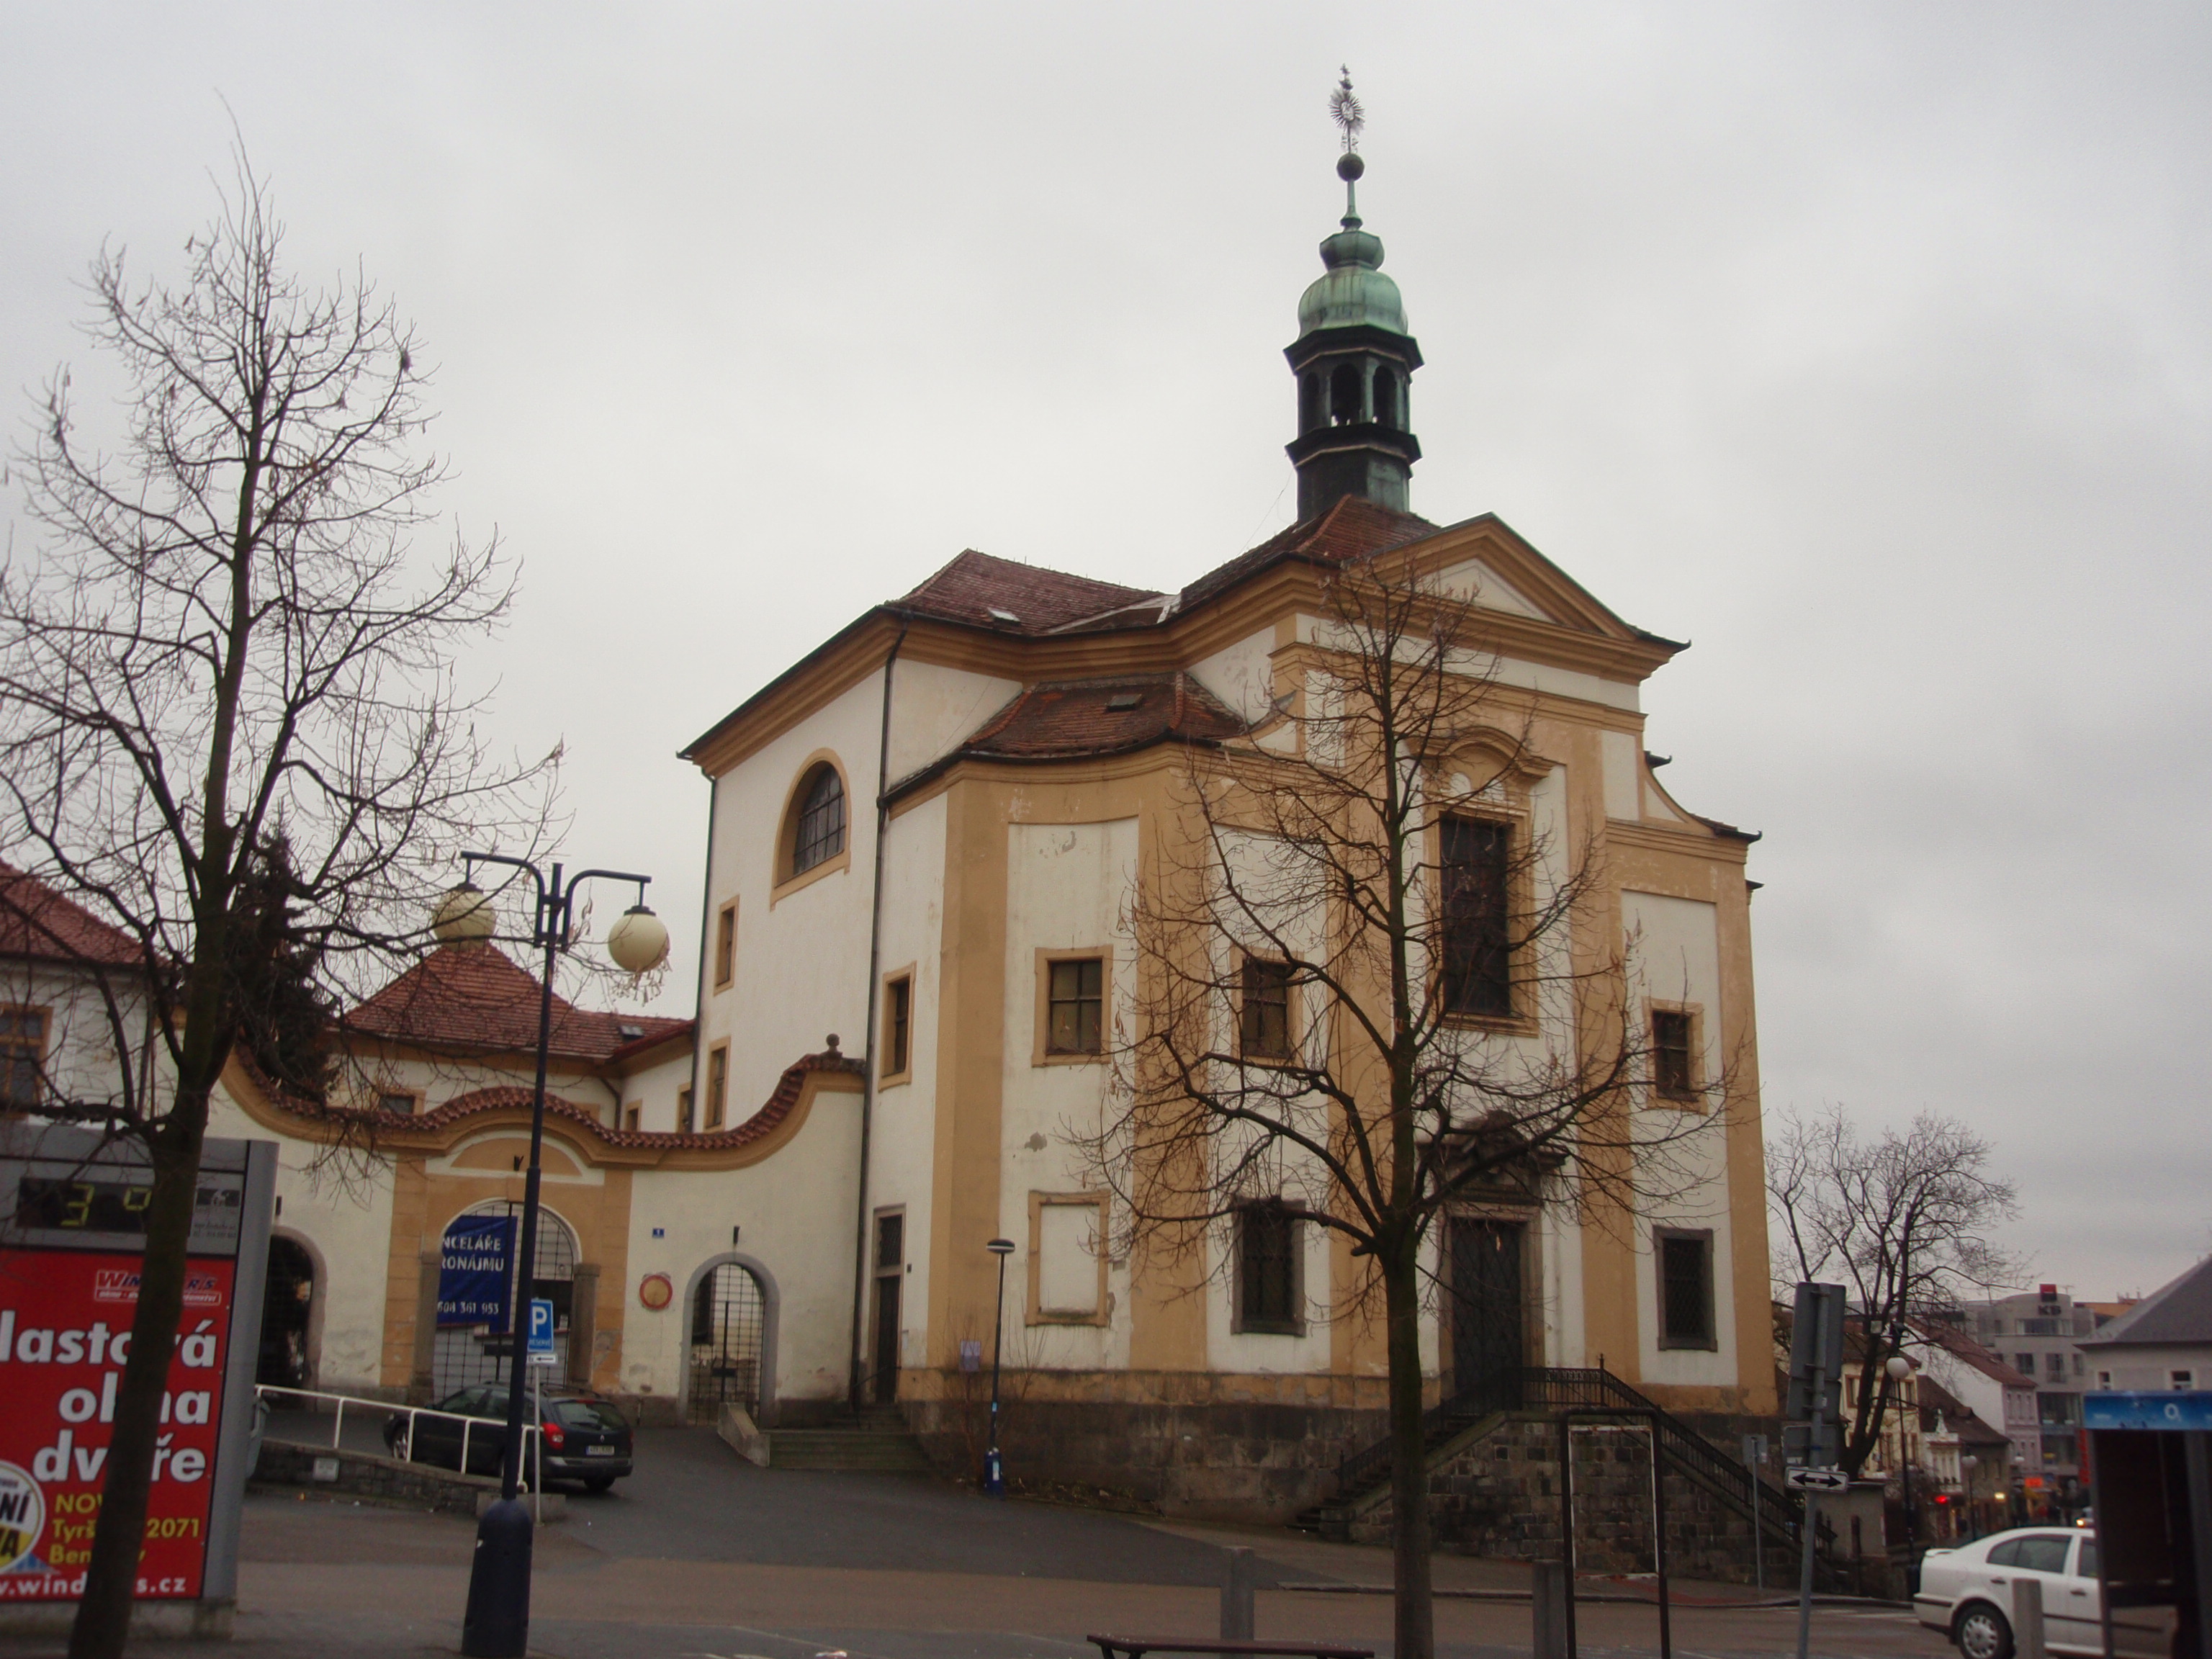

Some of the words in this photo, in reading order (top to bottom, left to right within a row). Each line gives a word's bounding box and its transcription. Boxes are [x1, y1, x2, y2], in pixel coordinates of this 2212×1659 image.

[532, 1305, 548, 1336] P
[32, 1429, 207, 1483] dvře
[146, 1517, 200, 1539] 2071
